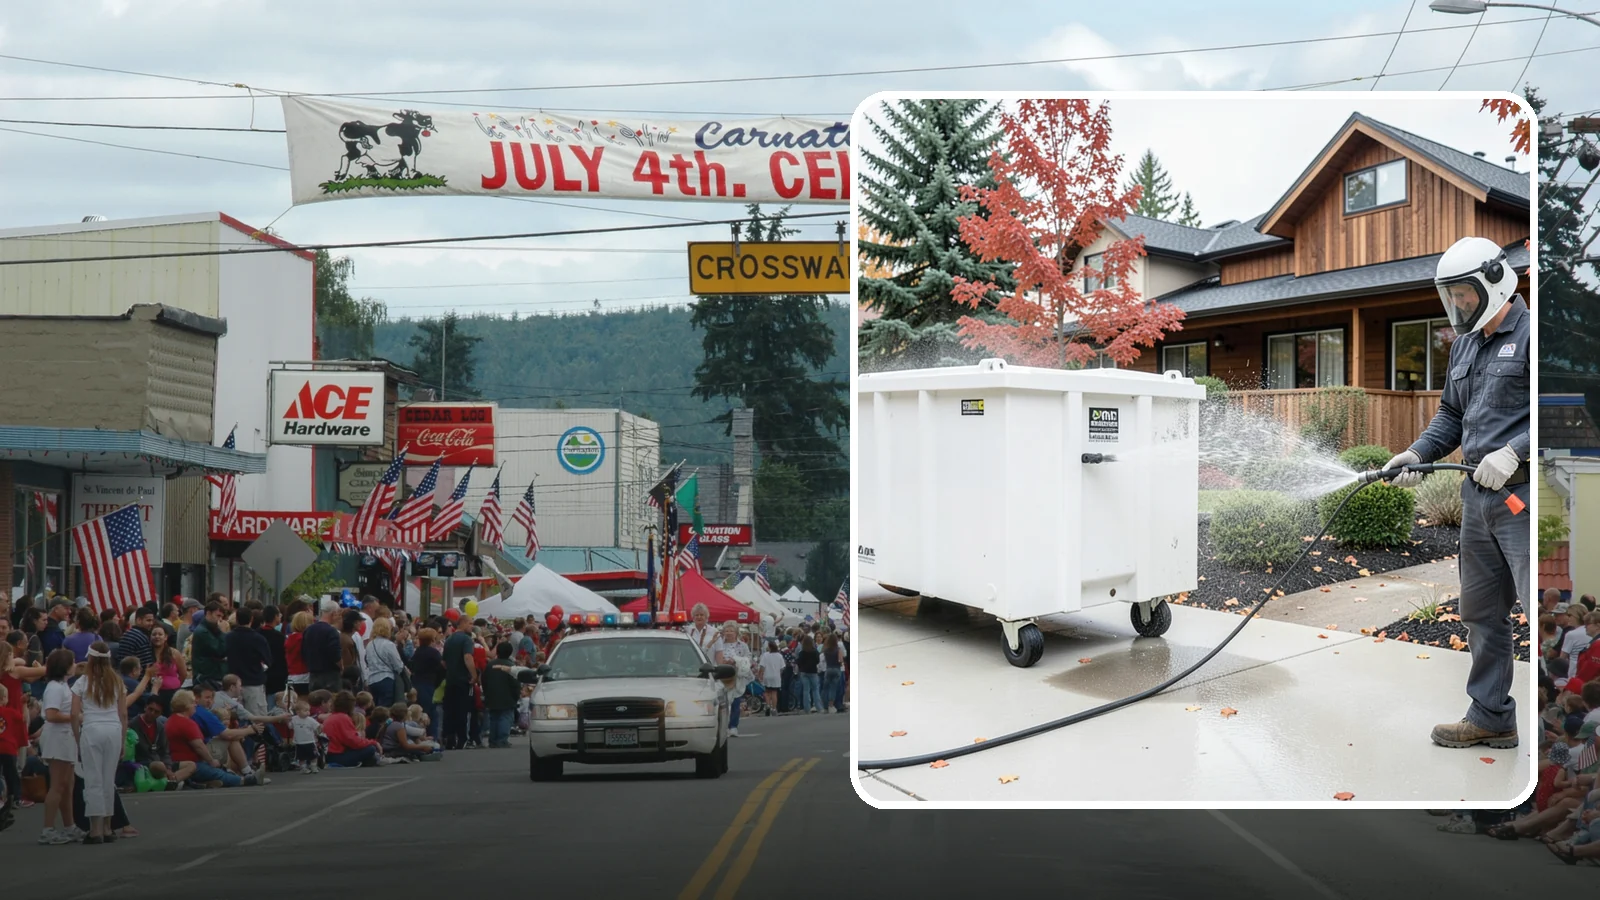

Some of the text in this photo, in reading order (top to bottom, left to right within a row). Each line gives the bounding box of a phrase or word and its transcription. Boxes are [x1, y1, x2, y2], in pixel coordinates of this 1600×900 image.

[481, 141, 605, 192] JULY
[632, 150, 746, 198] 4th.
[697, 254, 850, 280] CROSSWA
[282, 379, 374, 420] ACE
[405, 409, 484, 421] CEDAR LOG
[283, 421, 371, 436] Hardware
[416, 428, 477, 447] Coca-Cola
[83, 485, 155, 495] St. Vincent de Paul
[212, 516, 330, 535] HARDARE
[688, 527, 741, 535] CRNATION
[699, 535, 730, 543] GLASS
